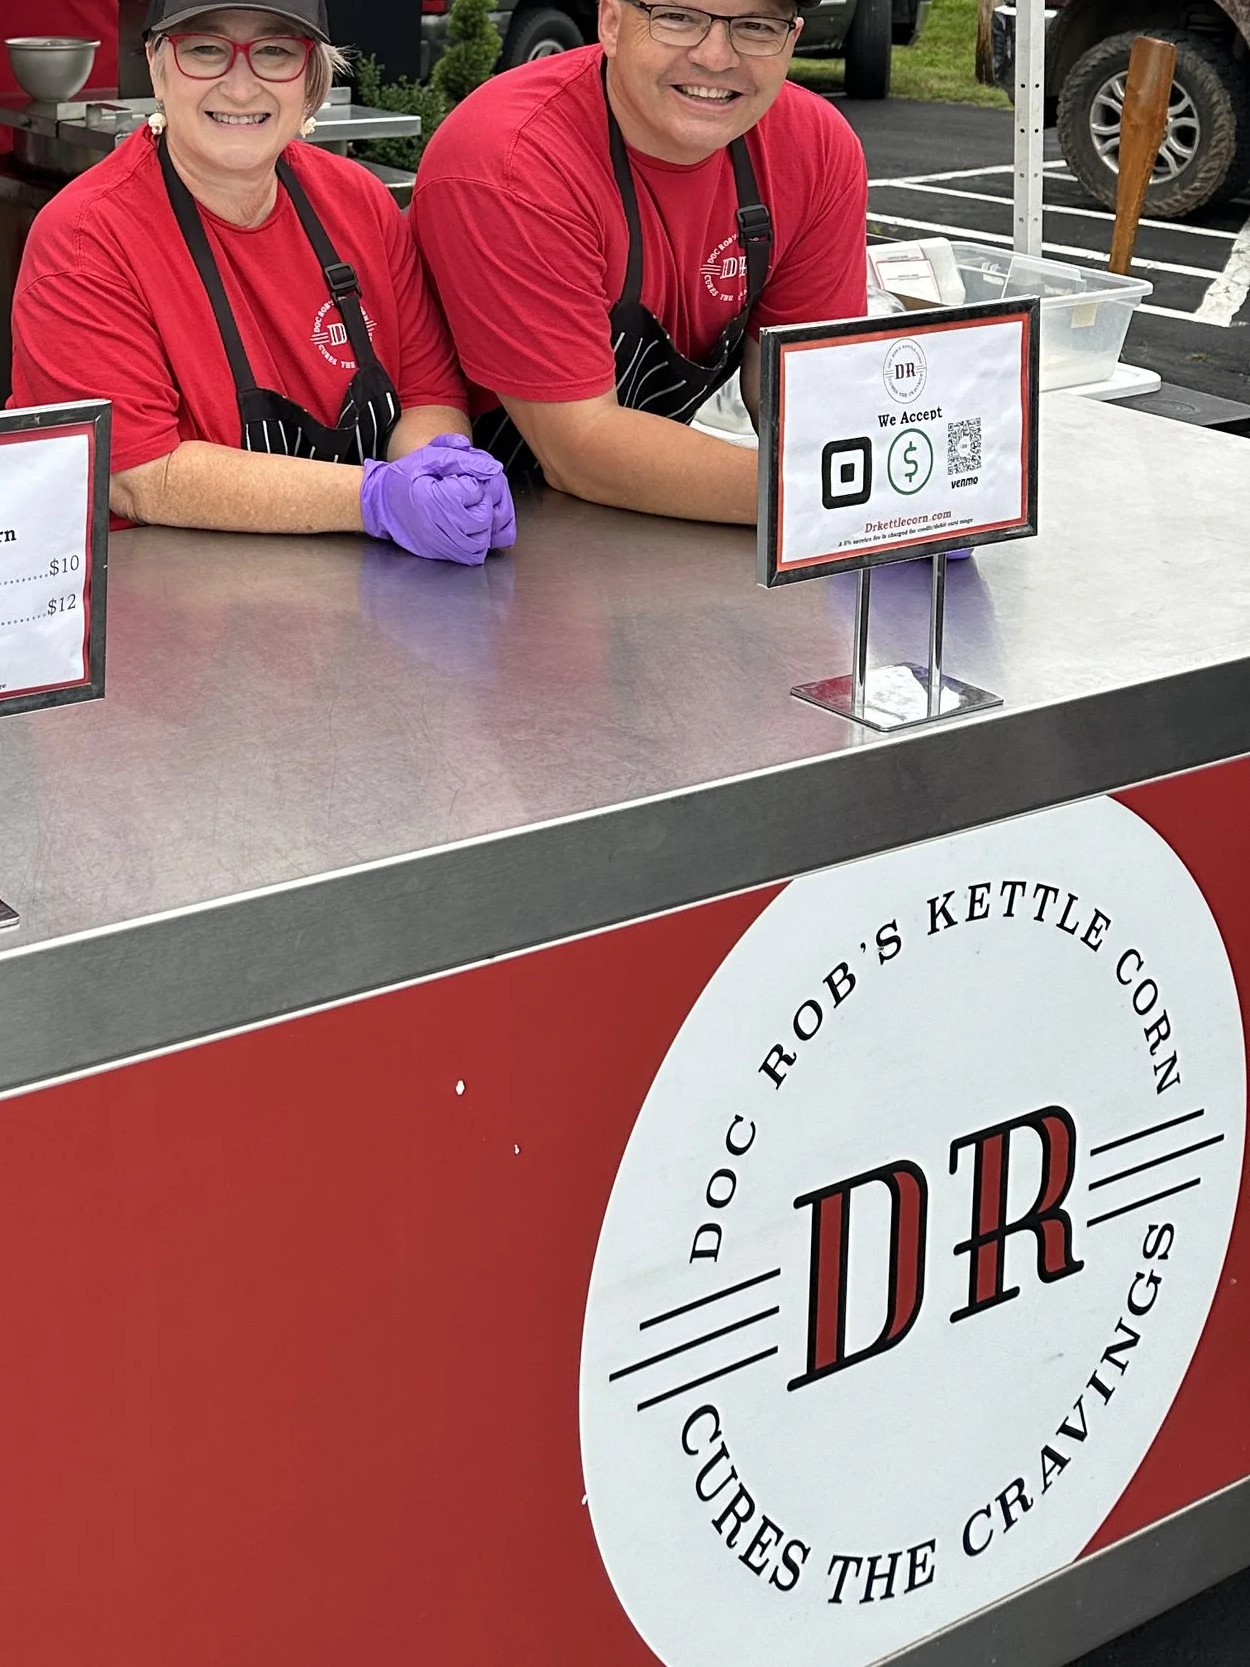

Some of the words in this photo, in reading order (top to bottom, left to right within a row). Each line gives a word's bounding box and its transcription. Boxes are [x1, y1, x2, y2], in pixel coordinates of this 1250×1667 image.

[327, 323, 347, 346] D
[894, 363, 916, 379] DR
[878, 414, 896, 428] We
[900, 406, 943, 424] Accept
[951, 476, 979, 489] venmo
[864, 511, 952, 533] Drkettlecorn.com
[49, 555, 80, 577] $10
[47, 594, 76, 616] $12
[689, 1112, 758, 1266] DOC
[757, 918, 905, 1091] ROB'S
[925, 879, 1112, 953] KETTLE
[1115, 948, 1183, 1097] CORN
[786, 1103, 1086, 1394] DR
[680, 1404, 813, 1593] CURES
[827, 1538, 938, 1606] THE
[962, 1220, 1177, 1558] CRAVINGS
